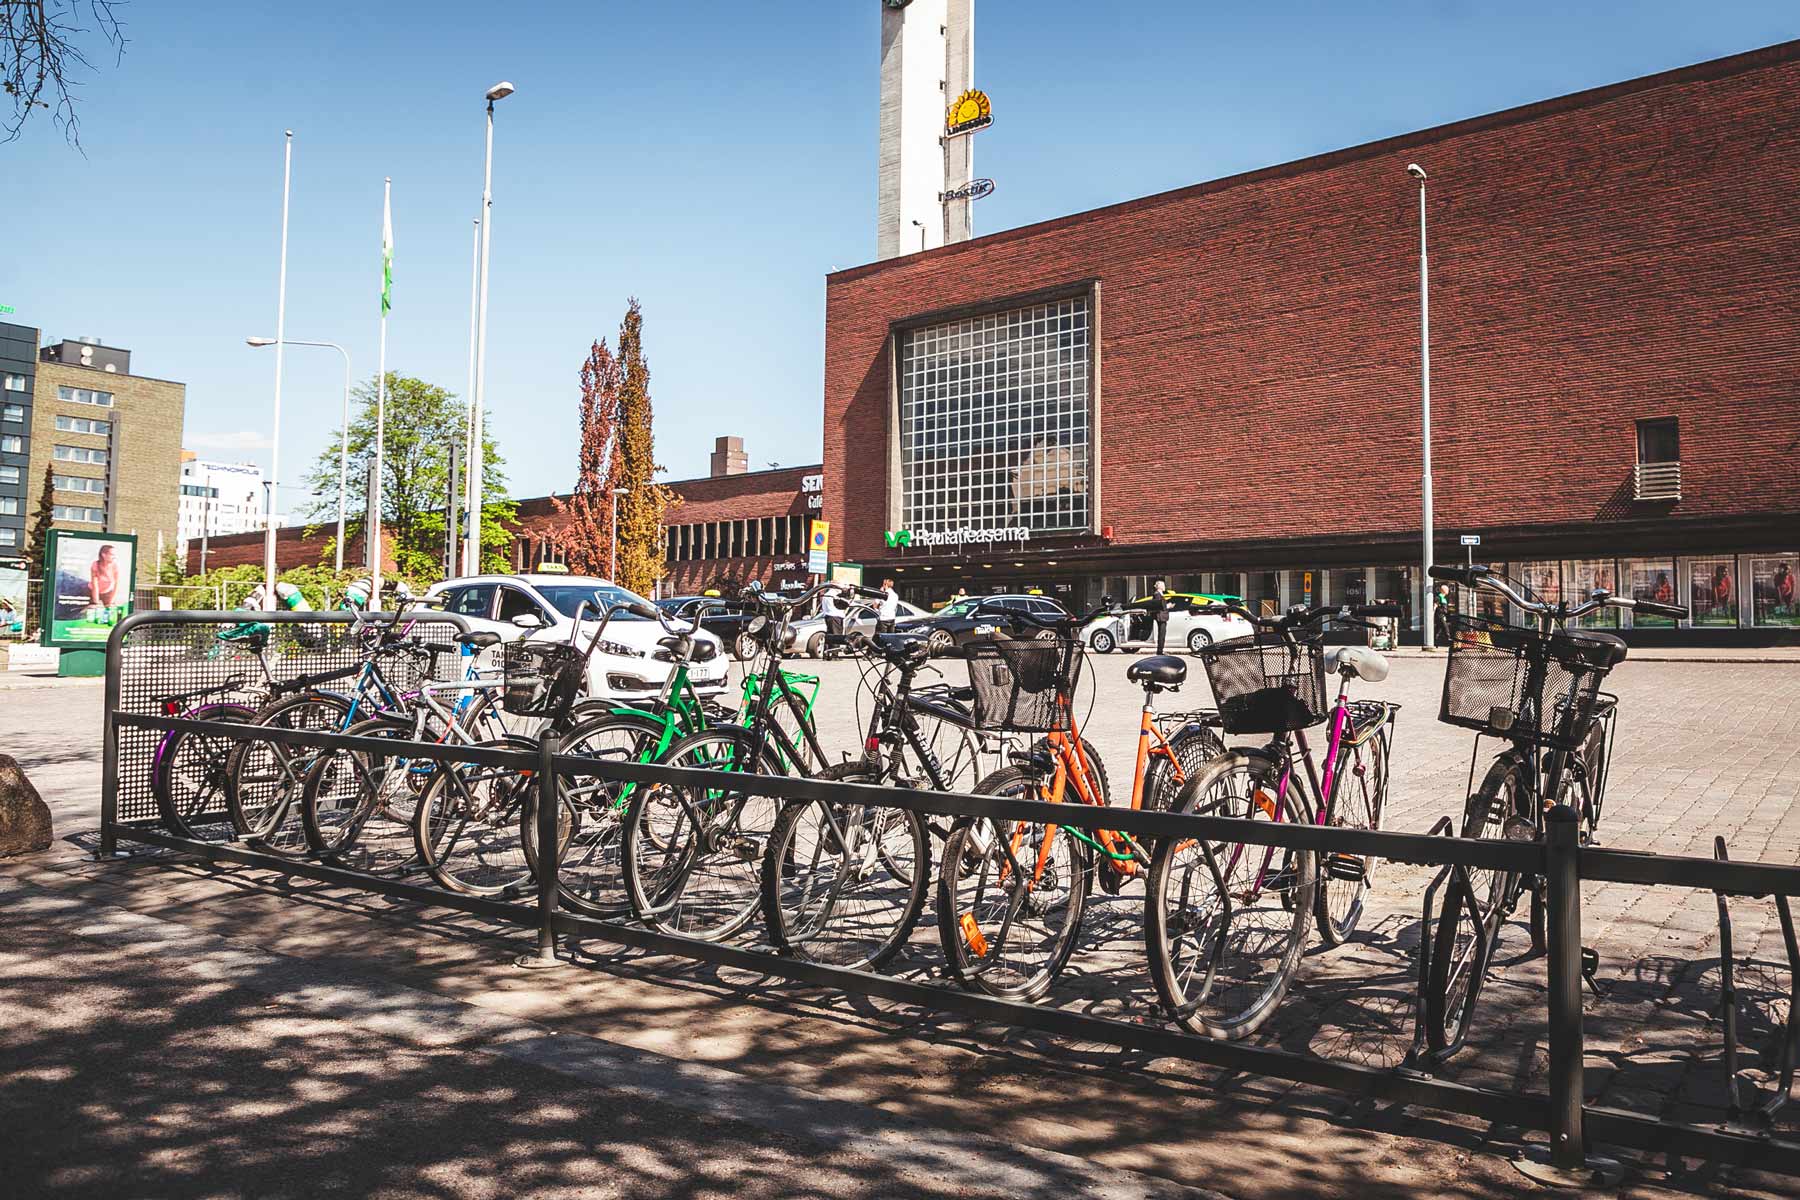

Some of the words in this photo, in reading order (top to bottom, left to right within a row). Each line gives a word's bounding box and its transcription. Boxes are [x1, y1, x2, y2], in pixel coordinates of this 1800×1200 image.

[945, 182, 991, 200] Bostik
[884, 529, 911, 548] VR
[915, 525, 1030, 546] Rautatieasema
